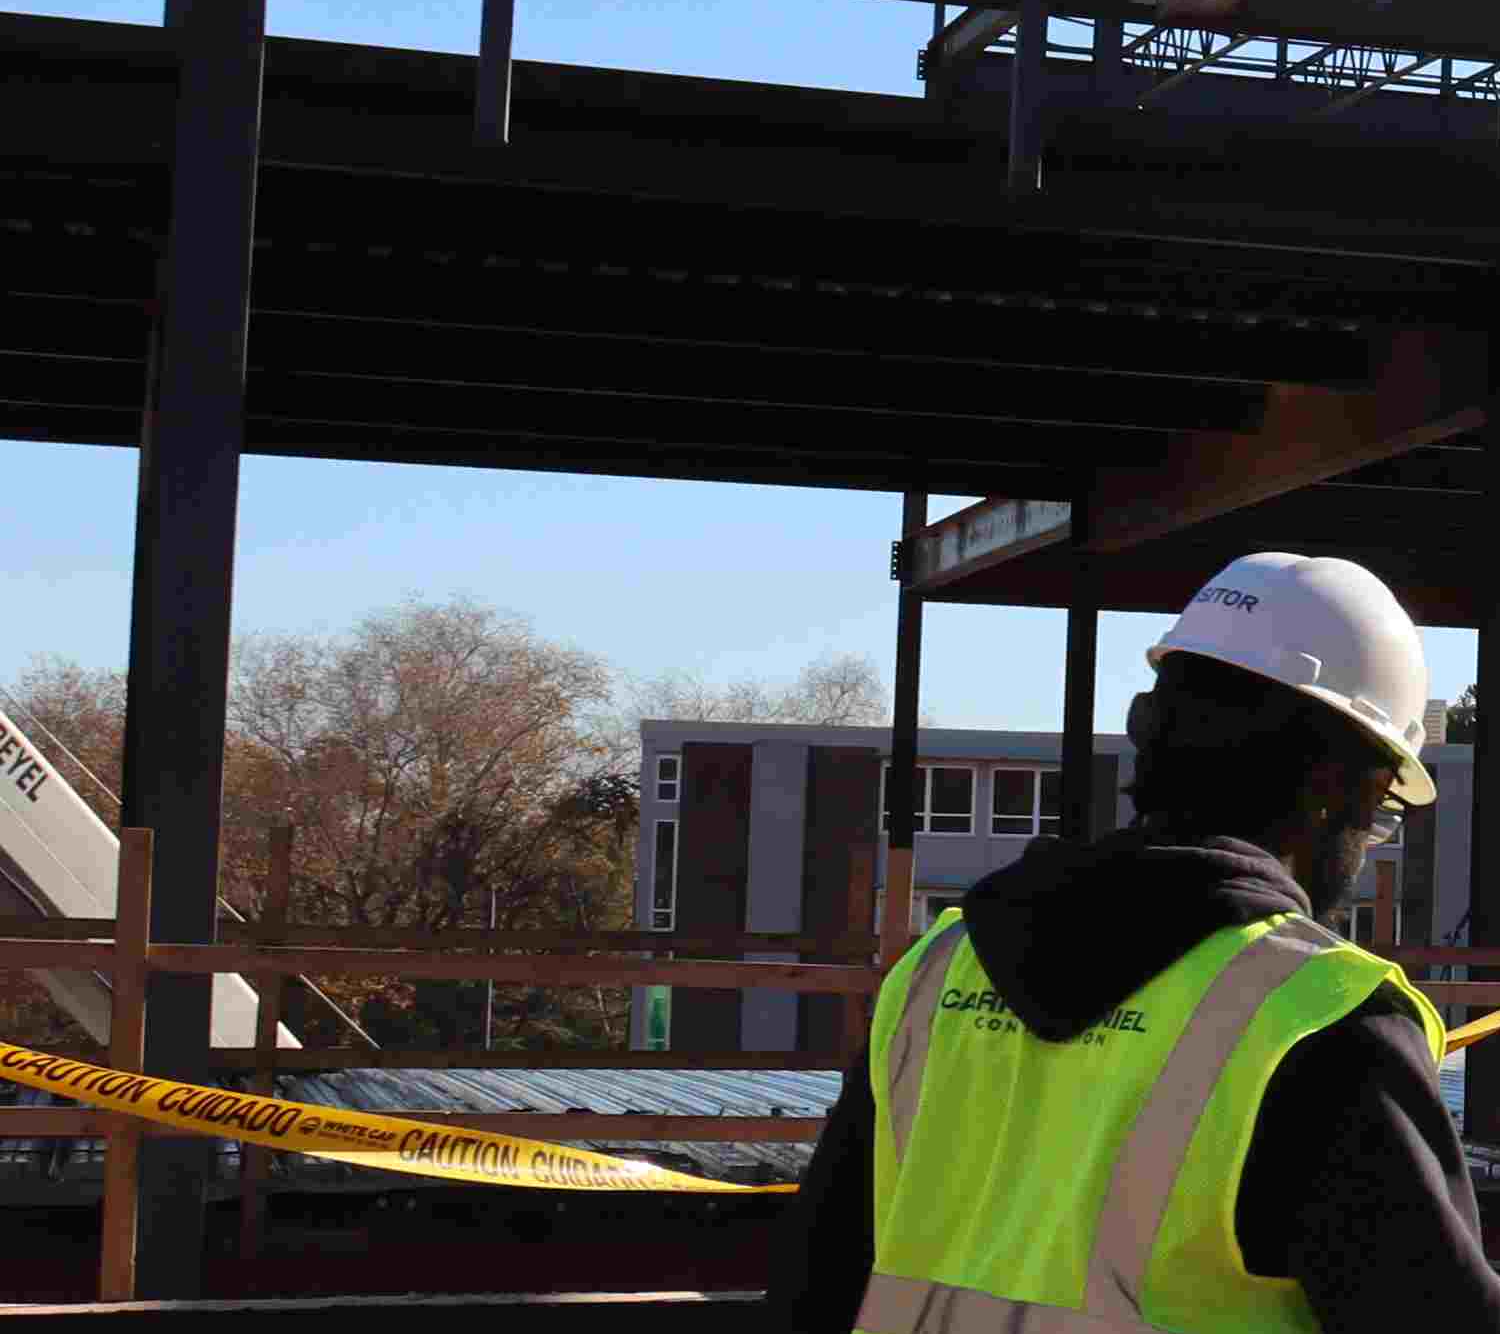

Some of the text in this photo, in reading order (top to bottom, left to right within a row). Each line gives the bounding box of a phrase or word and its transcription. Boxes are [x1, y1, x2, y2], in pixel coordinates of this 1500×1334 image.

[1, 1049, 153, 1103] CAUTION
[157, 1086, 303, 1137] CUIDADO
[400, 1129, 519, 1179] CAUTION
